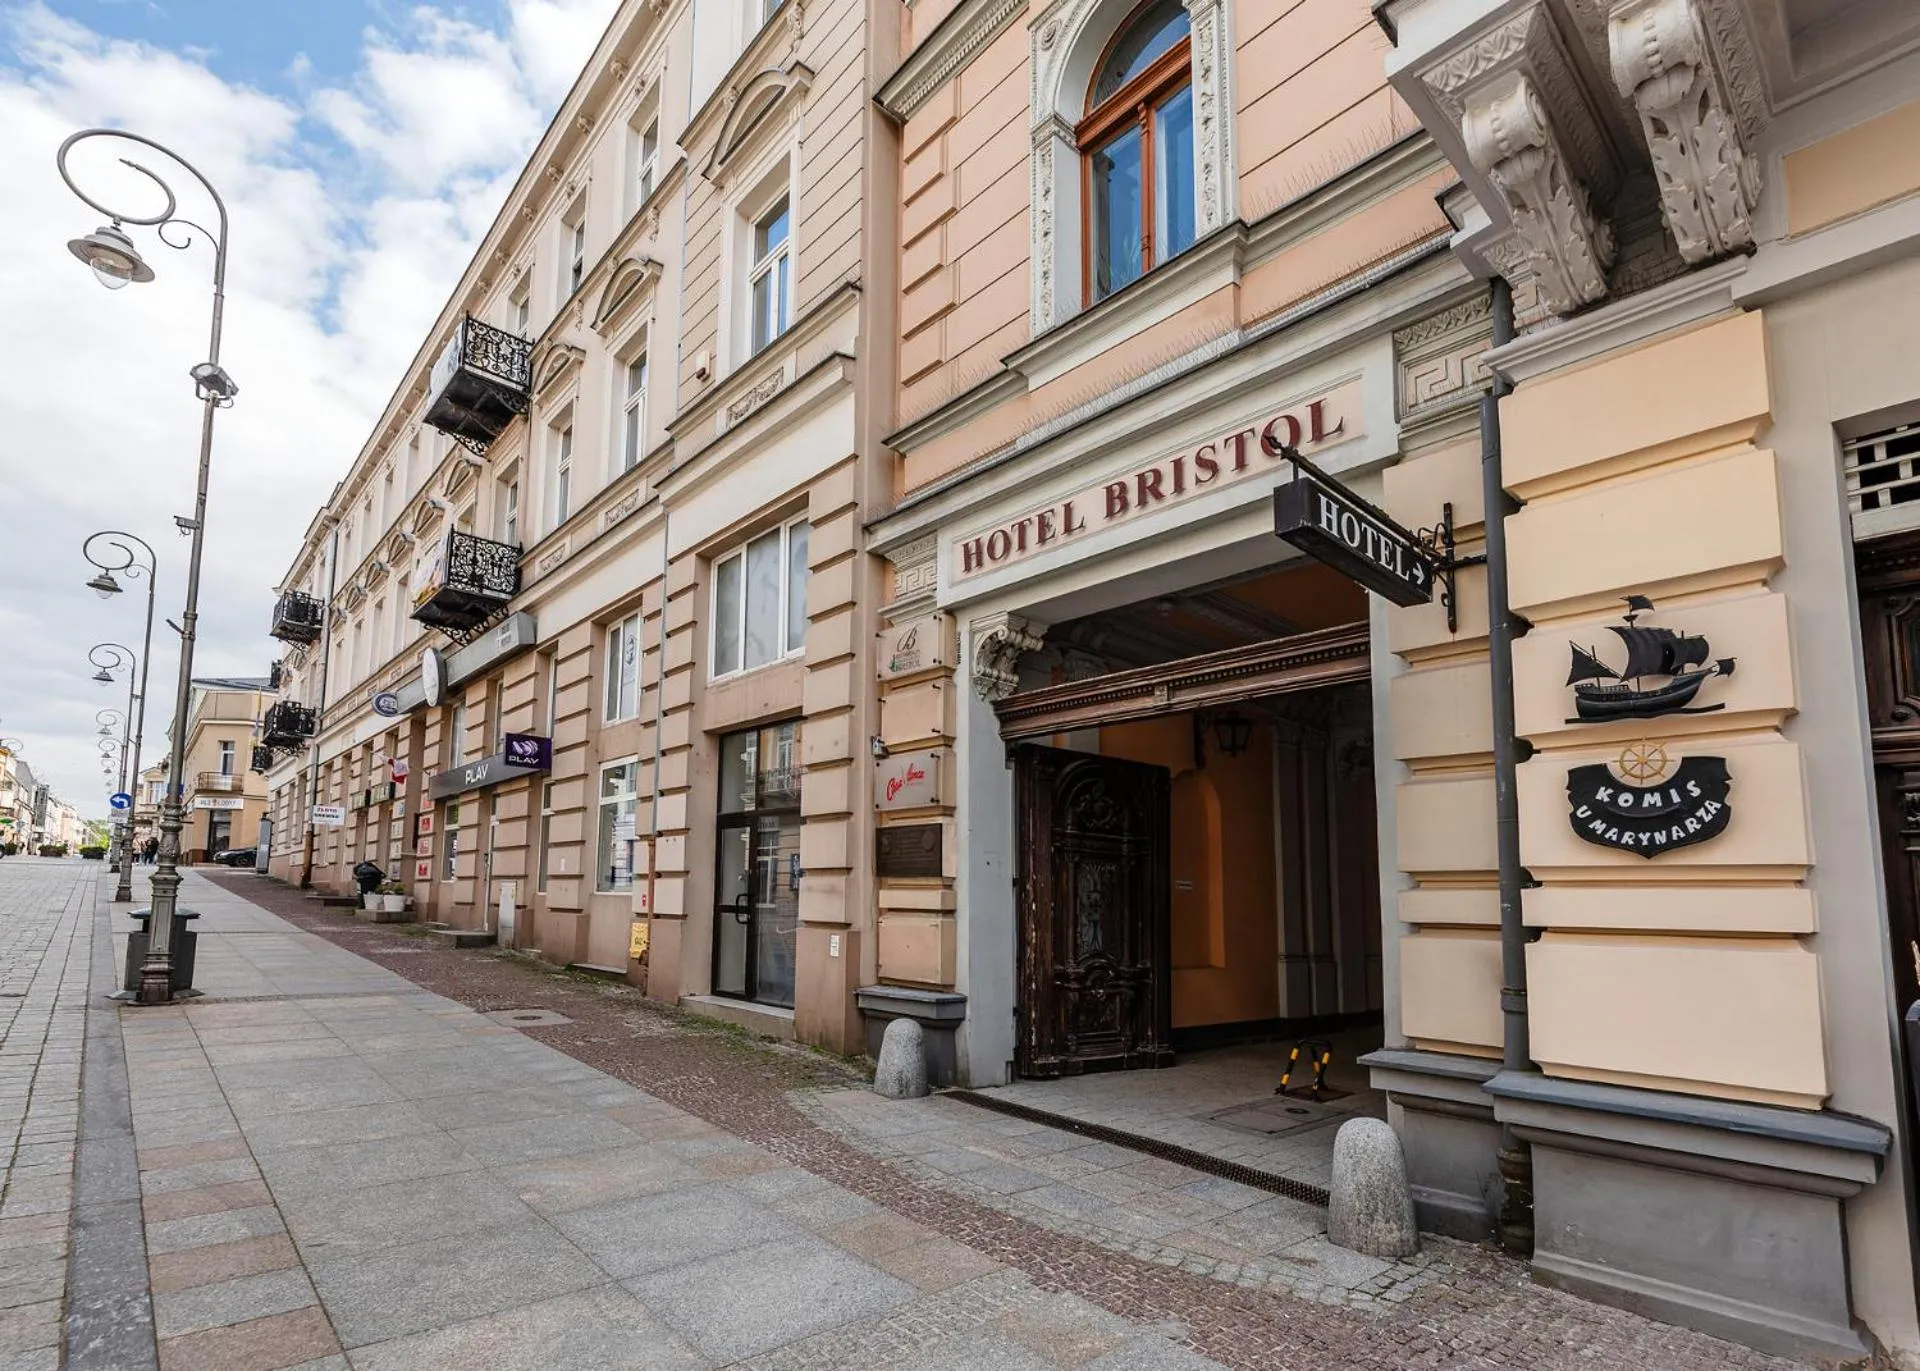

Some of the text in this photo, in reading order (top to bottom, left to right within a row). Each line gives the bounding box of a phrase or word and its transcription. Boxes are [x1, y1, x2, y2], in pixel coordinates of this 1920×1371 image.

[962, 398, 1345, 574] HOTEL BRISTOL
[1317, 493, 1410, 582] HOTEL
[465, 763, 489, 785] PLAY
[508, 755, 540, 765] PLAY
[1595, 779, 1703, 808] KOMIS
[1576, 799, 1723, 846] U MARYNARZA
